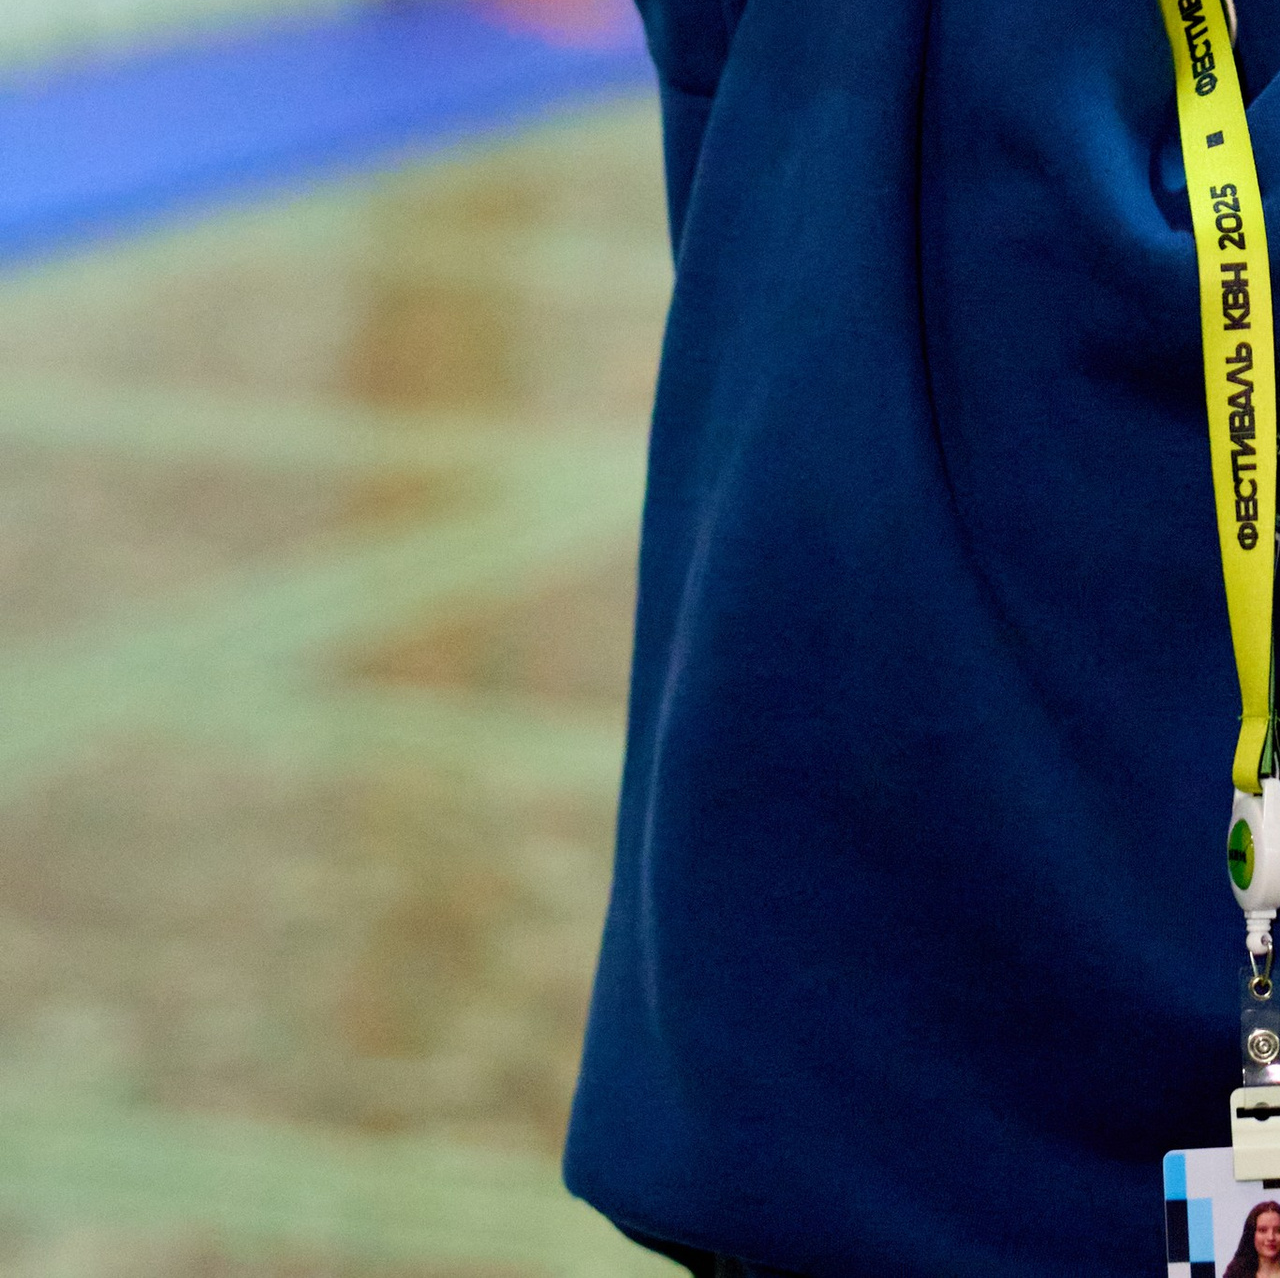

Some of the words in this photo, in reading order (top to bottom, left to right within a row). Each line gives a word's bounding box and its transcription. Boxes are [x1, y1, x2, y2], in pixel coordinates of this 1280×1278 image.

[1210, 183, 1246, 251] 2025
[1220, 262, 1251, 331] КВН
[1225, 342, 1259, 551] ФЕСТИВАЛЬ
